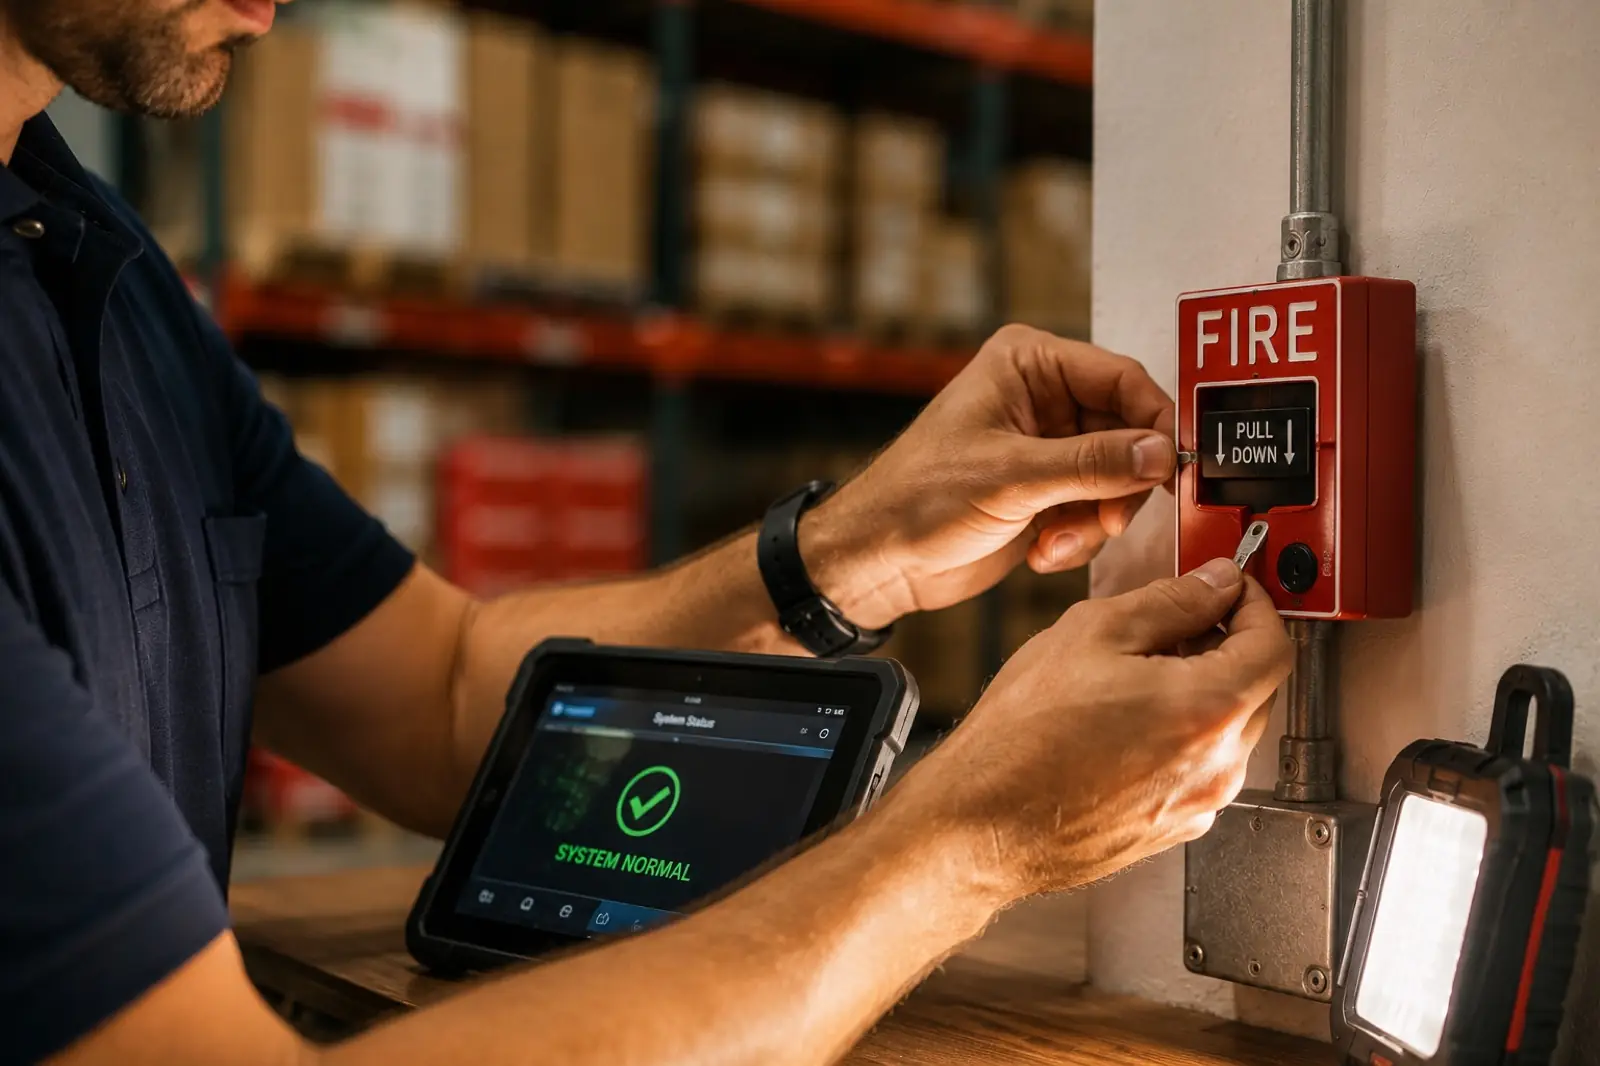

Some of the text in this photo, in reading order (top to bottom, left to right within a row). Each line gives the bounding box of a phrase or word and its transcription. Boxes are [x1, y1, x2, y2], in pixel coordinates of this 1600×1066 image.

[1197, 300, 1318, 369] FIRE
[1236, 420, 1274, 440] PULL
[1232, 445, 1277, 464] DOWN
[653, 711, 716, 729] System Status
[555, 843, 691, 882] SYSTEM NORMAL
